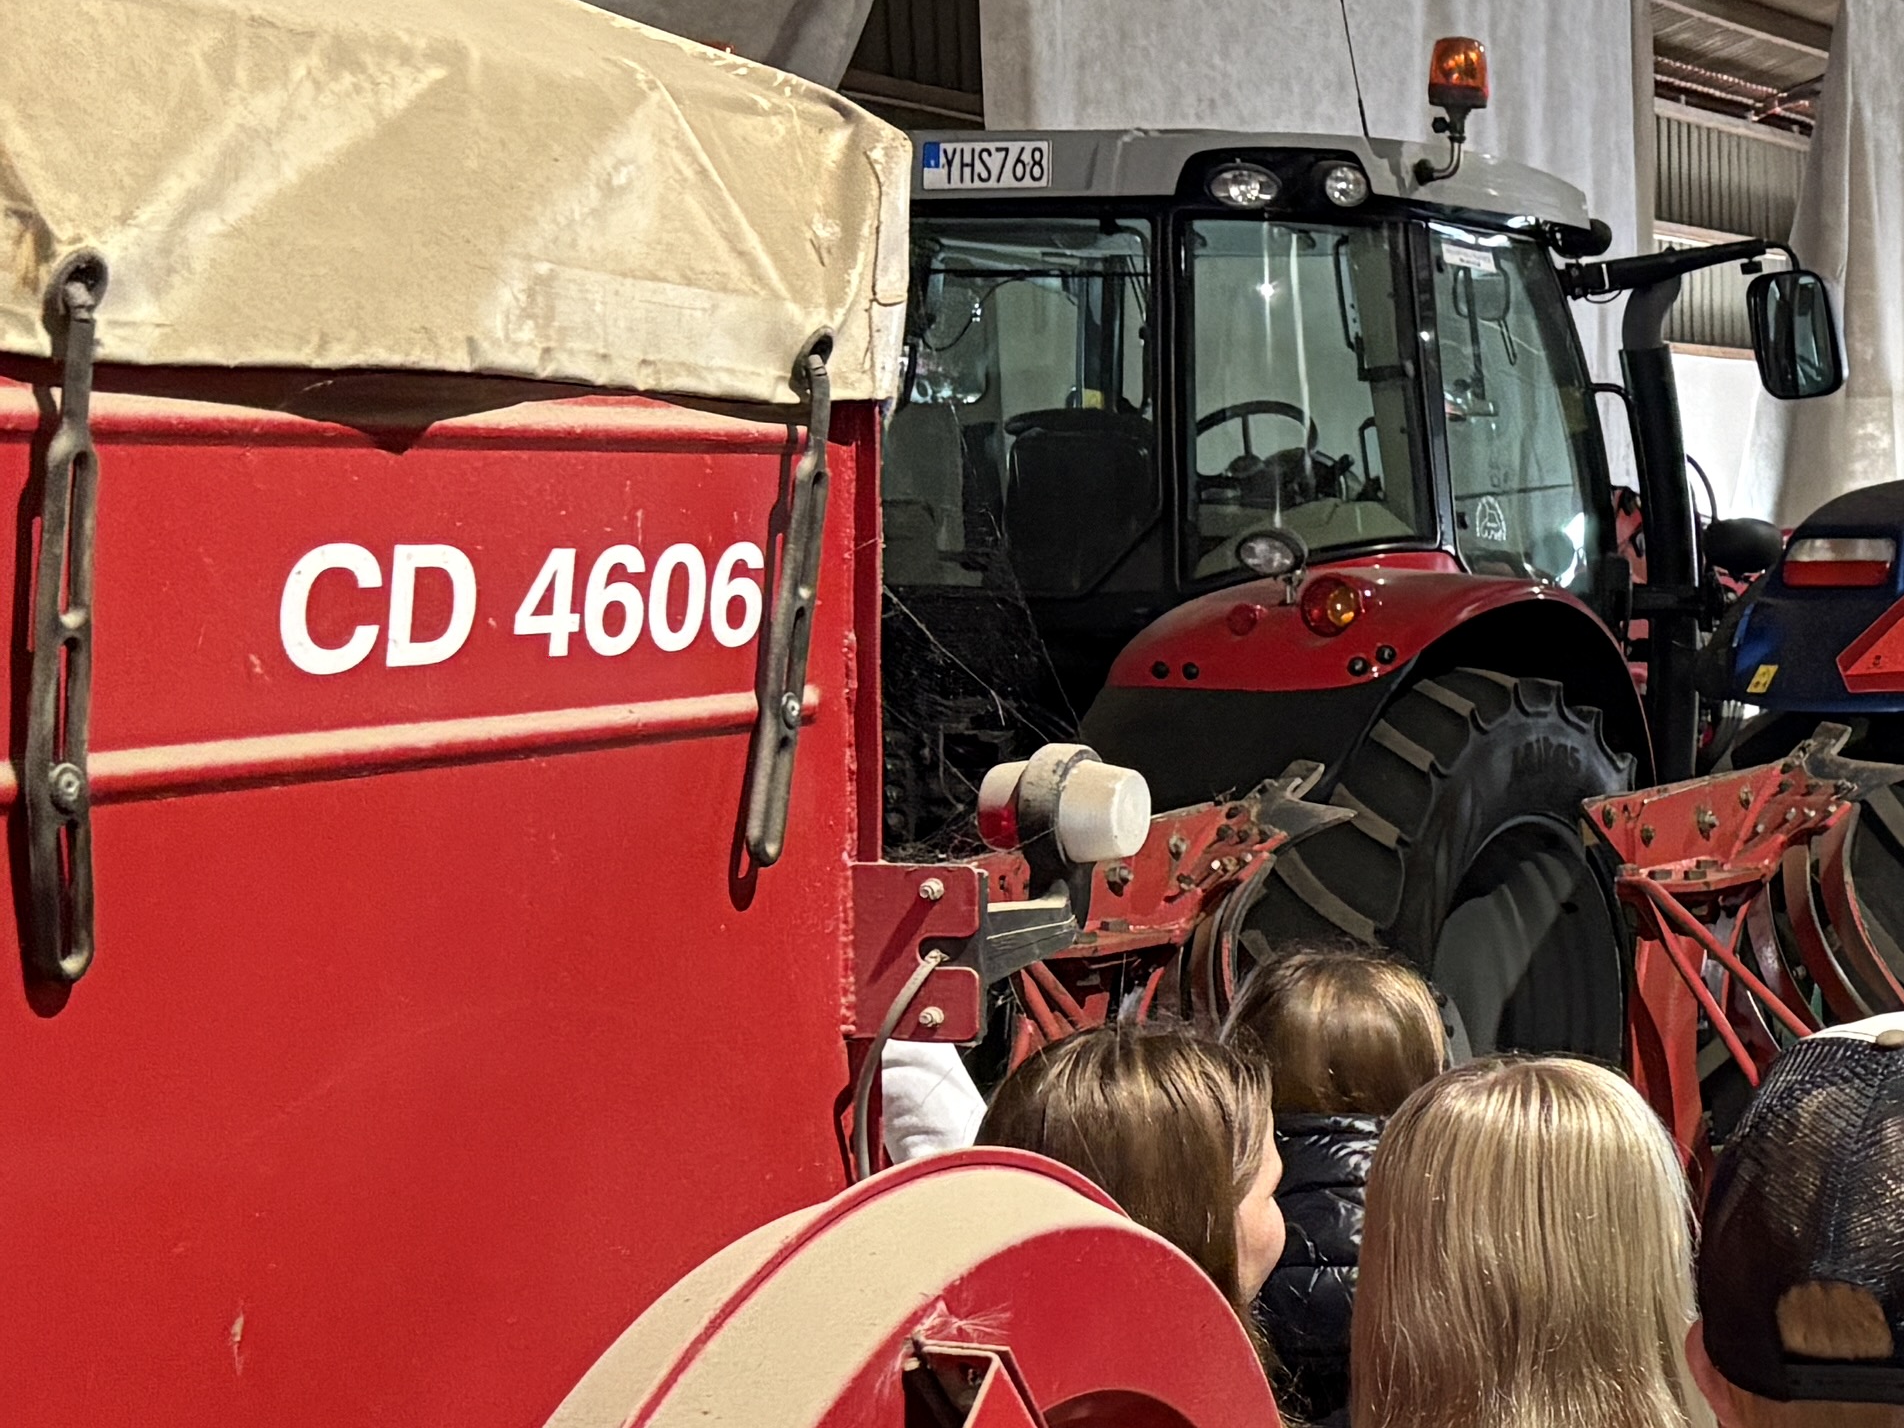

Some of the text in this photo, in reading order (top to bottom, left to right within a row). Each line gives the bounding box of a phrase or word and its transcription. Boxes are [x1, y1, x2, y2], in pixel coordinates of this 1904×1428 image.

[943, 146, 1045, 185] YHS768
[280, 541, 765, 676] CD 4606
